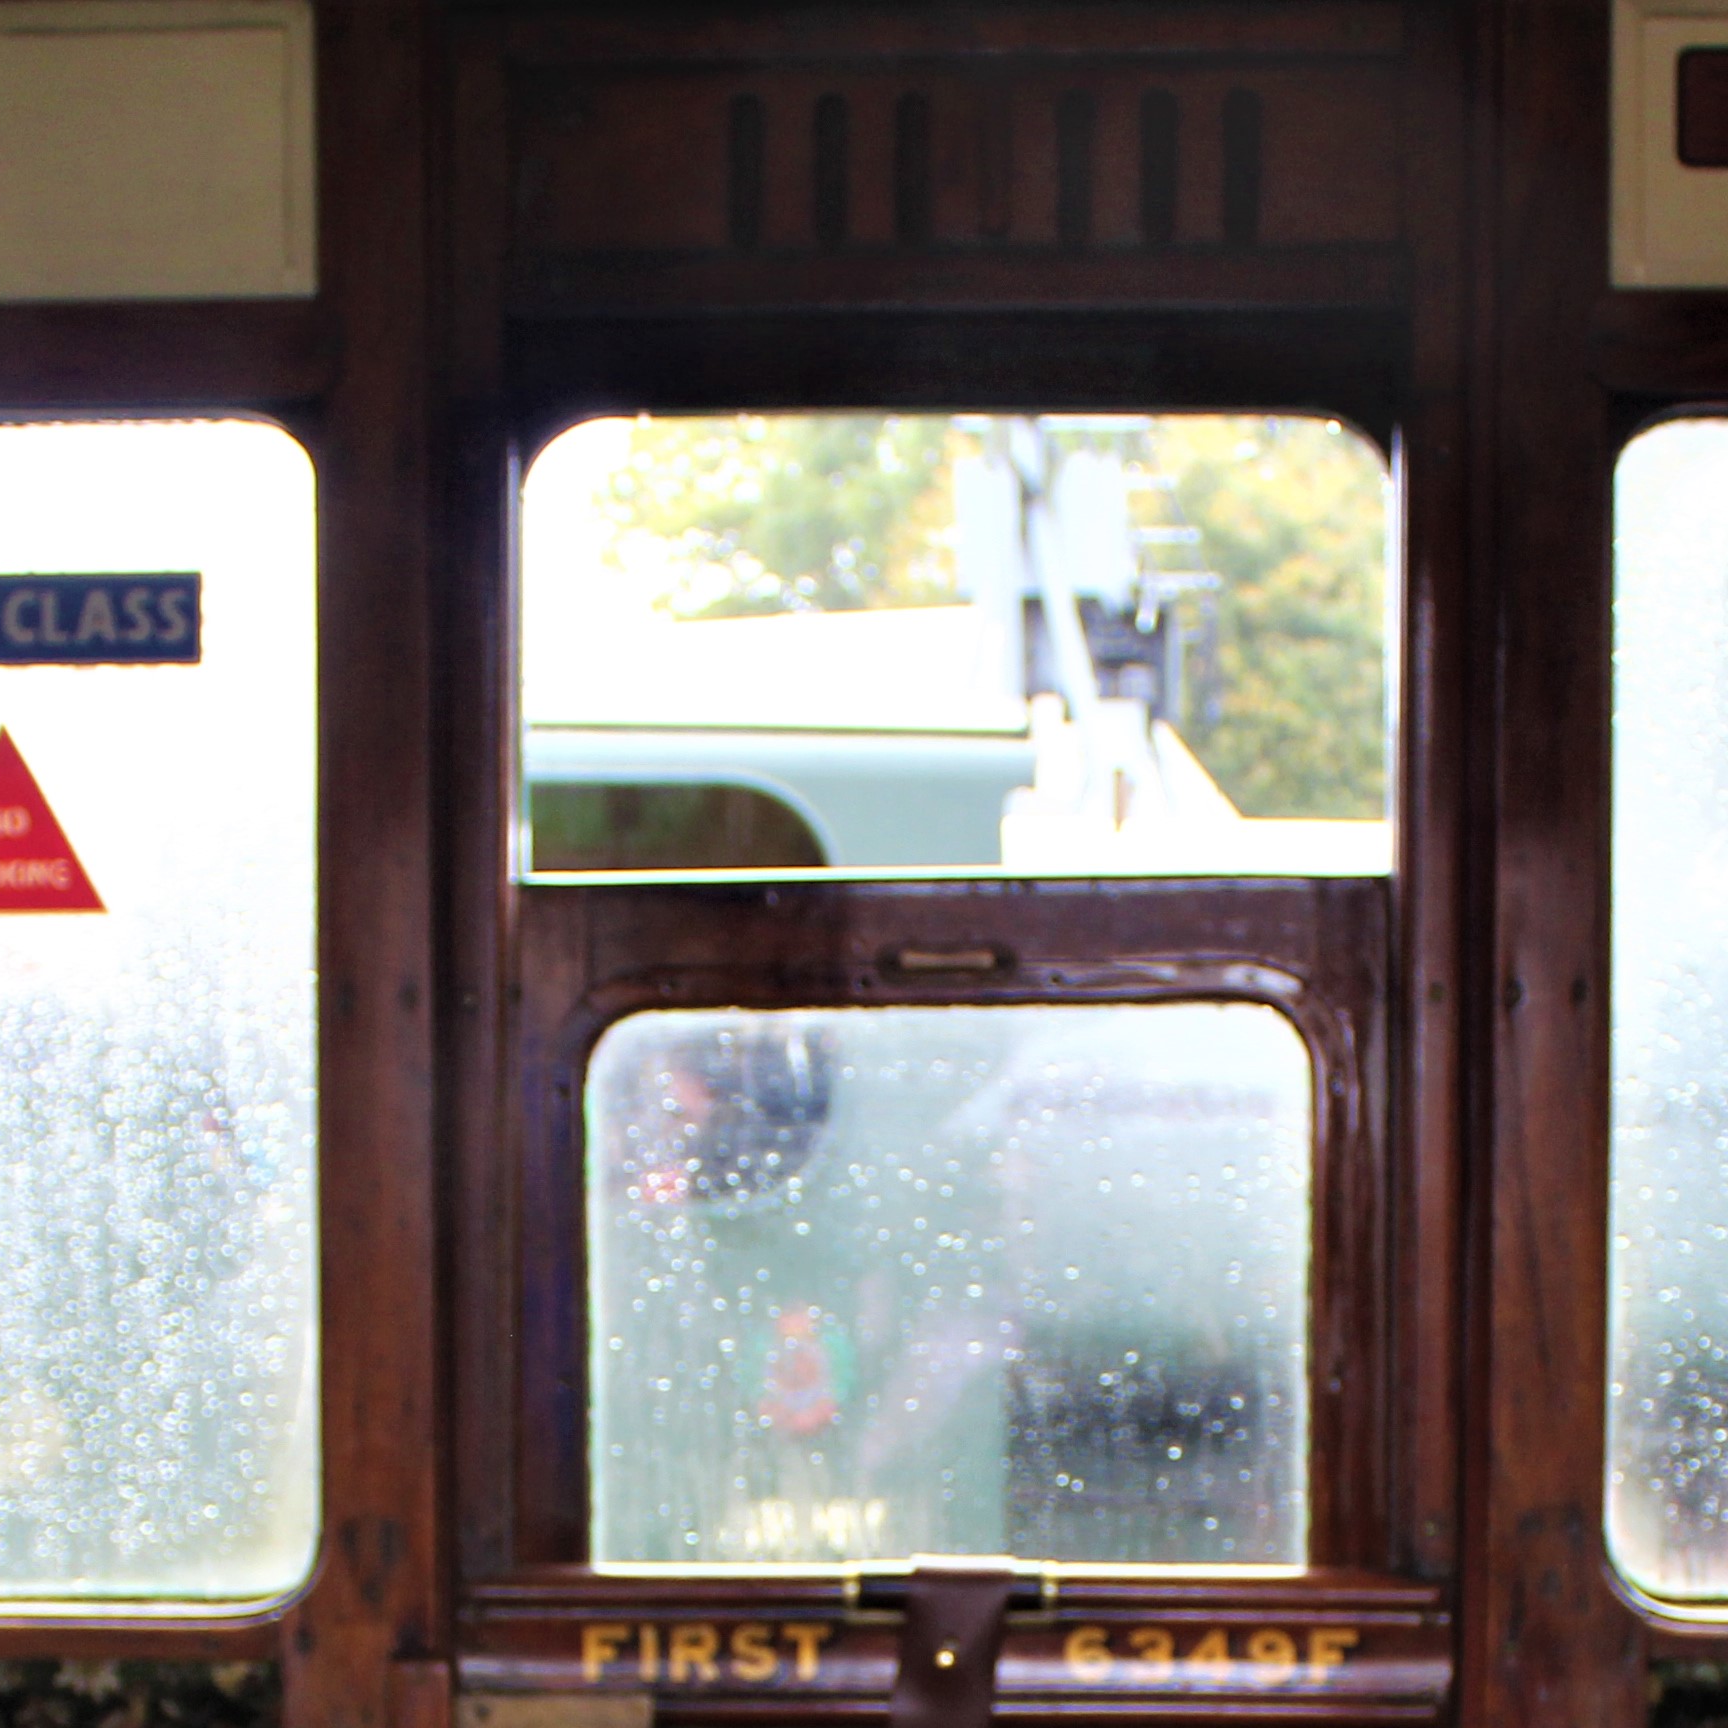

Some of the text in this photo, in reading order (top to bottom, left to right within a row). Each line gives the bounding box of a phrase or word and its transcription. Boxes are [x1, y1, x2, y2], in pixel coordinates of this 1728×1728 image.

[3, 586, 189, 645] CLASS
[581, 1622, 1361, 1688] FIRST 6349F
